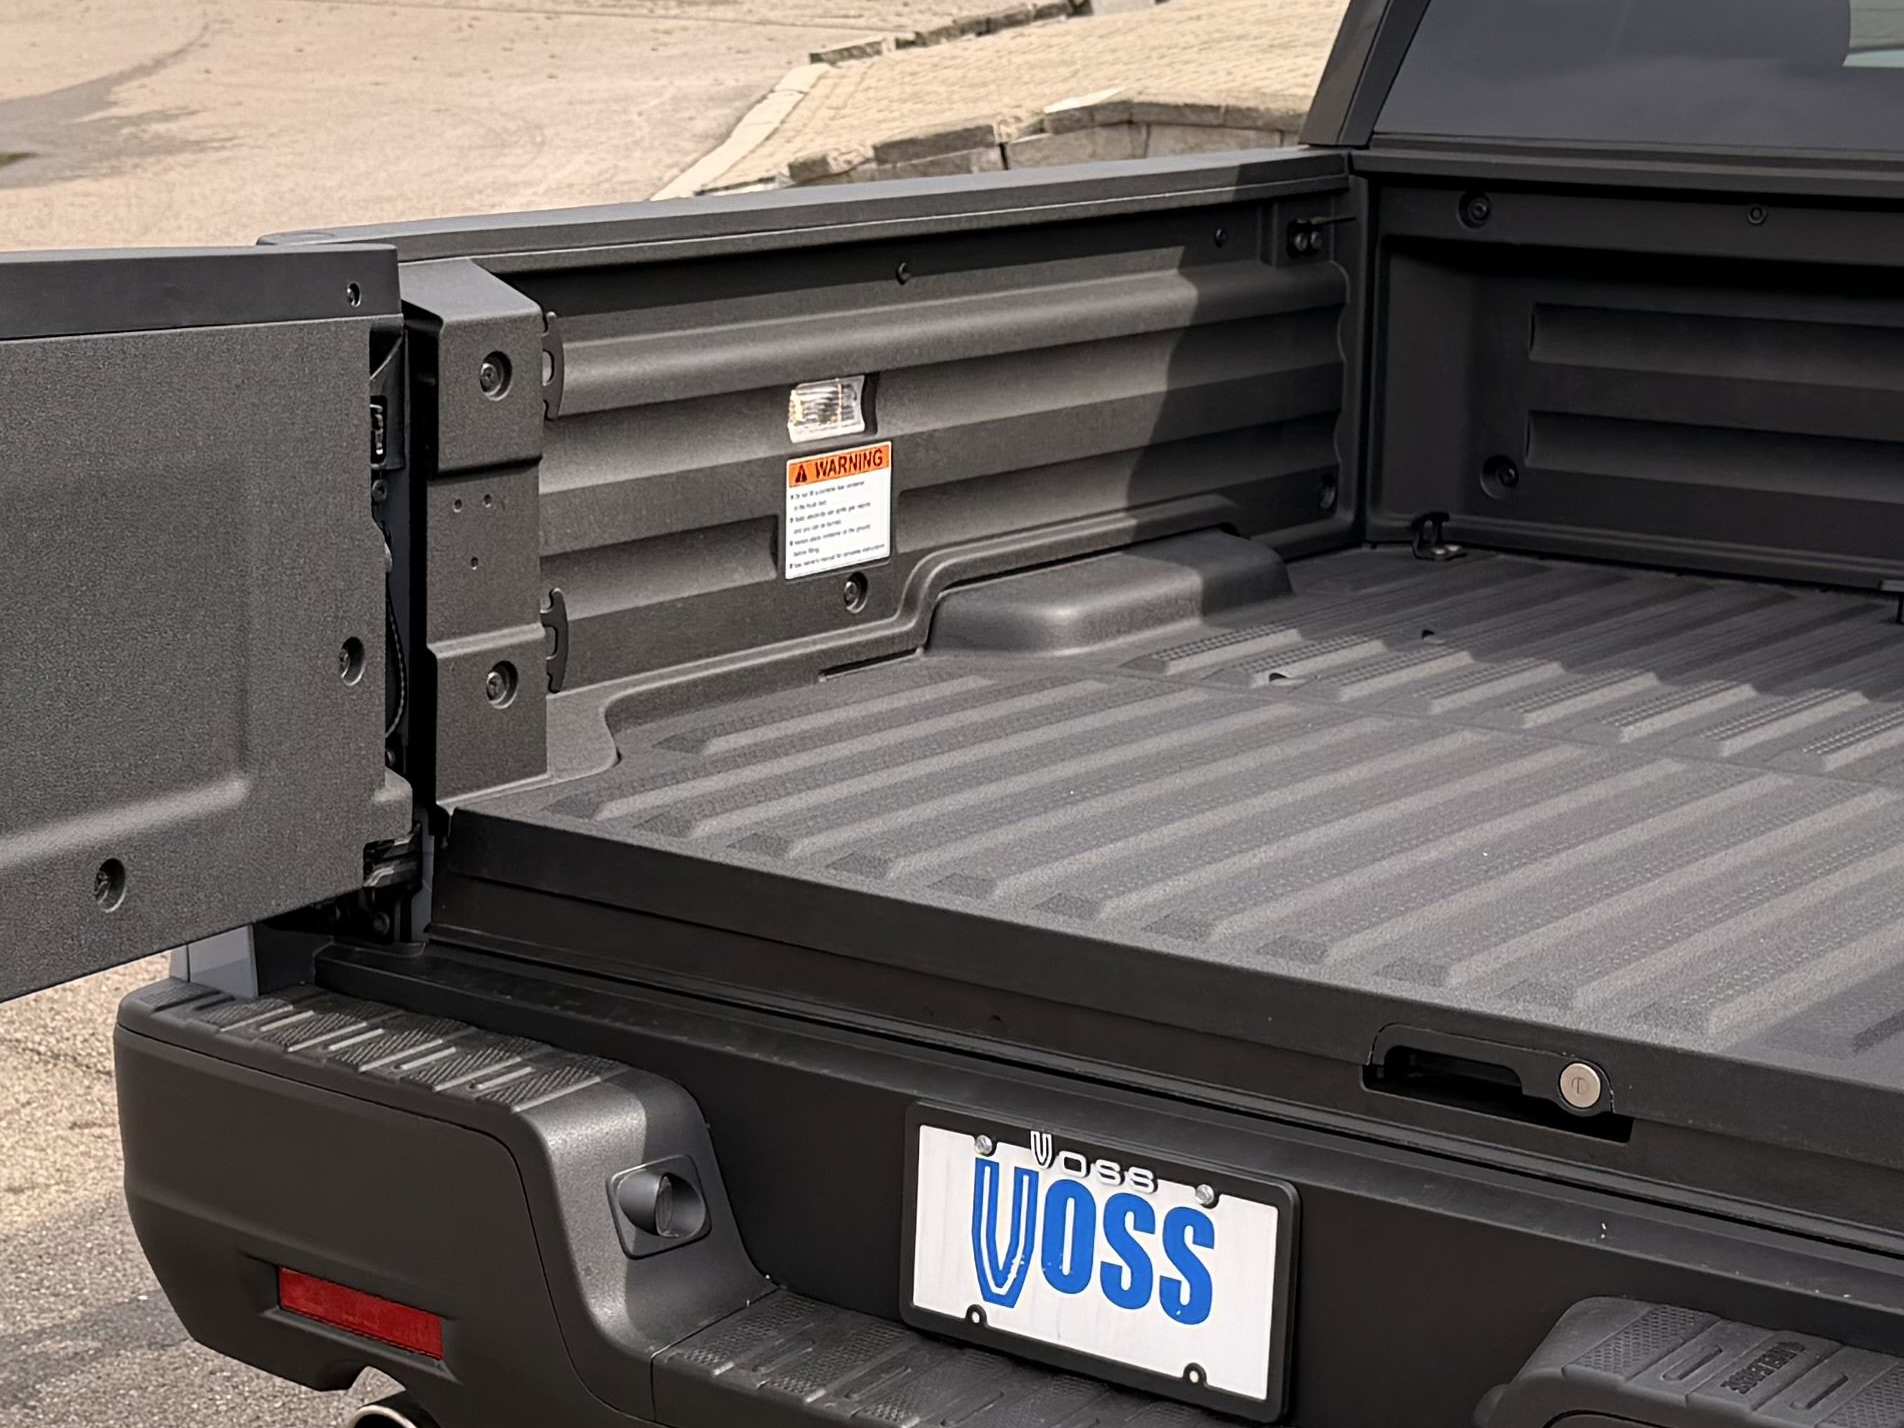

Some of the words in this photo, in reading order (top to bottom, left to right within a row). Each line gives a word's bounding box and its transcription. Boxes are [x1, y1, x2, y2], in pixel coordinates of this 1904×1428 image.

[815, 448, 883, 478] WARNING
[1030, 1130, 1157, 1194] VOSS
[971, 1156, 1216, 1325] VOSS
